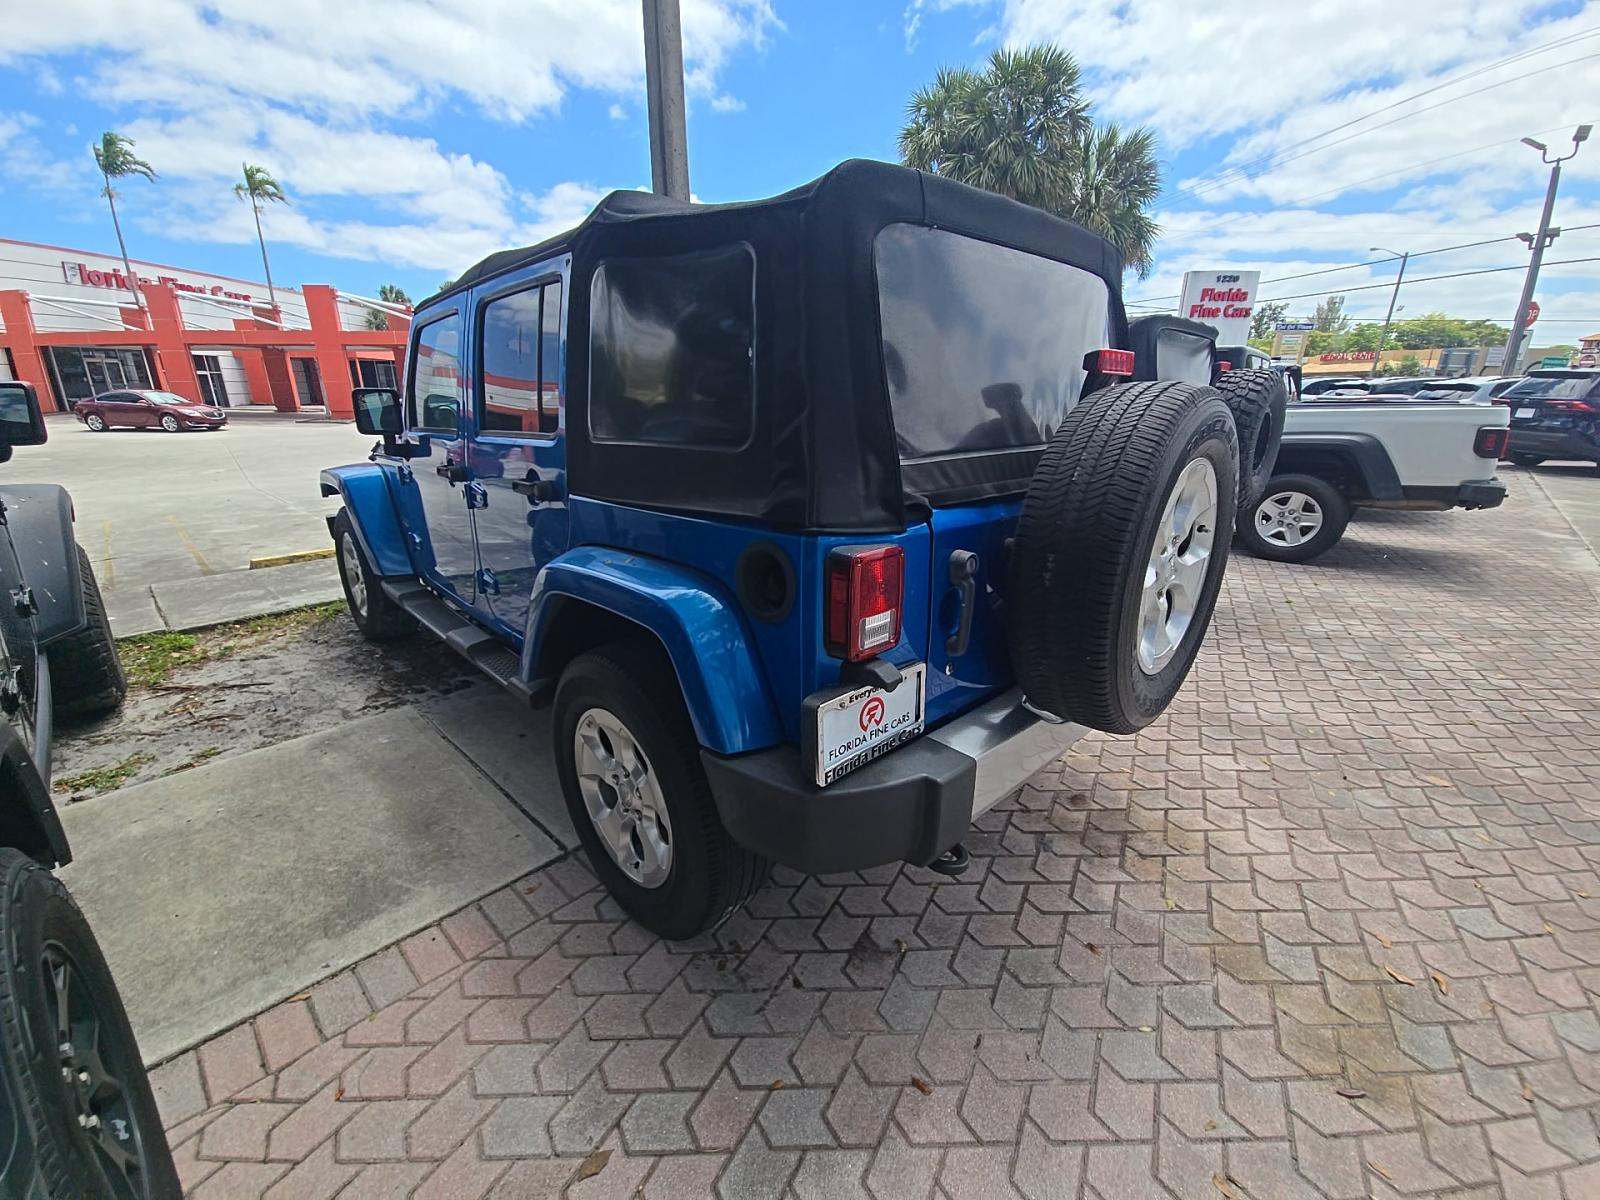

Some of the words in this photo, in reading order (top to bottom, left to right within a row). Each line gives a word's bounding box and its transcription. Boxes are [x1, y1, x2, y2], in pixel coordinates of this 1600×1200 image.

[1200, 287, 1249, 302] Florida
[1189, 304, 1221, 318] Fine
[1223, 304, 1253, 318] Cars
[1353, 351, 1376, 361] CENTE
[829, 734, 867, 761] FLORIDA
[869, 723, 889, 740] FINE
[890, 712, 910, 729] CARS
[824, 752, 868, 784] Florida
[871, 736, 897, 759] Fine
[898, 723, 923, 741] Cars
